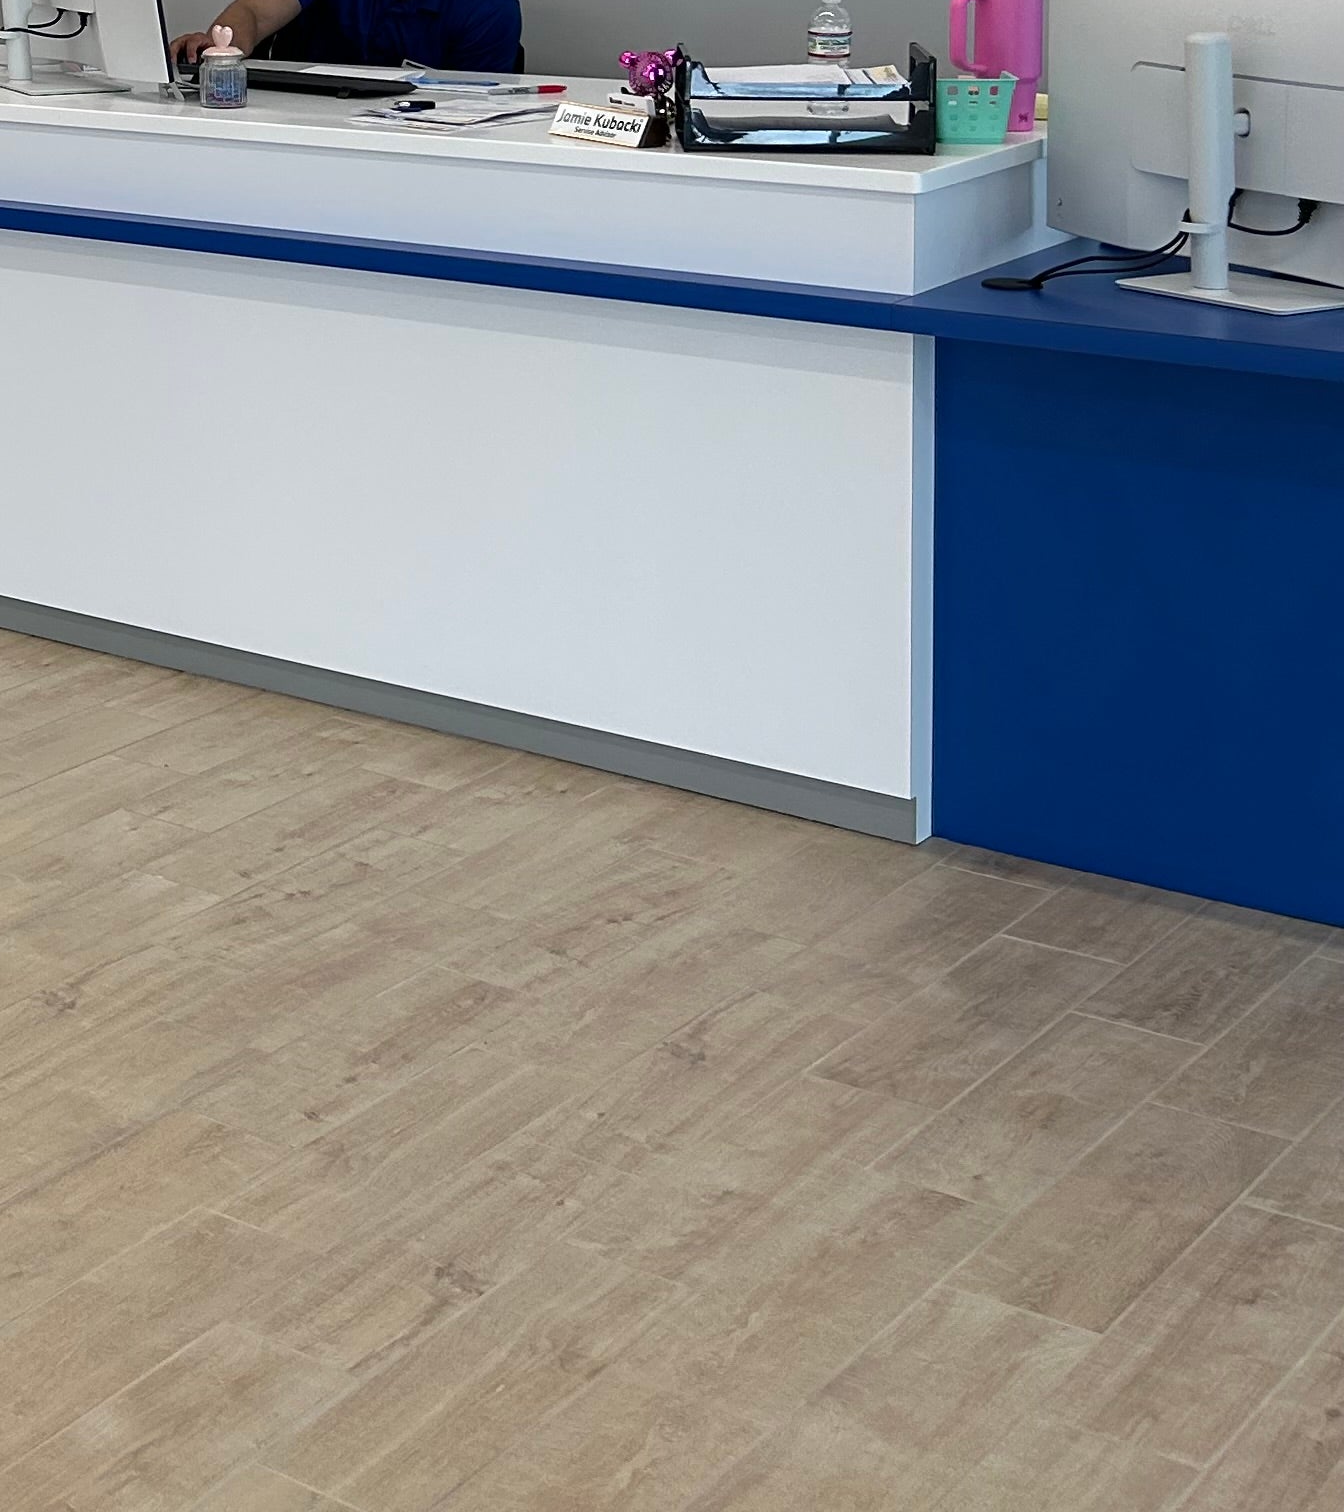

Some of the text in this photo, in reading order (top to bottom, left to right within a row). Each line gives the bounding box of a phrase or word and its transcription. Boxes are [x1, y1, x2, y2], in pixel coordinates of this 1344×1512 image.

[556, 108, 644, 134] Jamie Kubacki
[574, 126, 594, 136] Service
